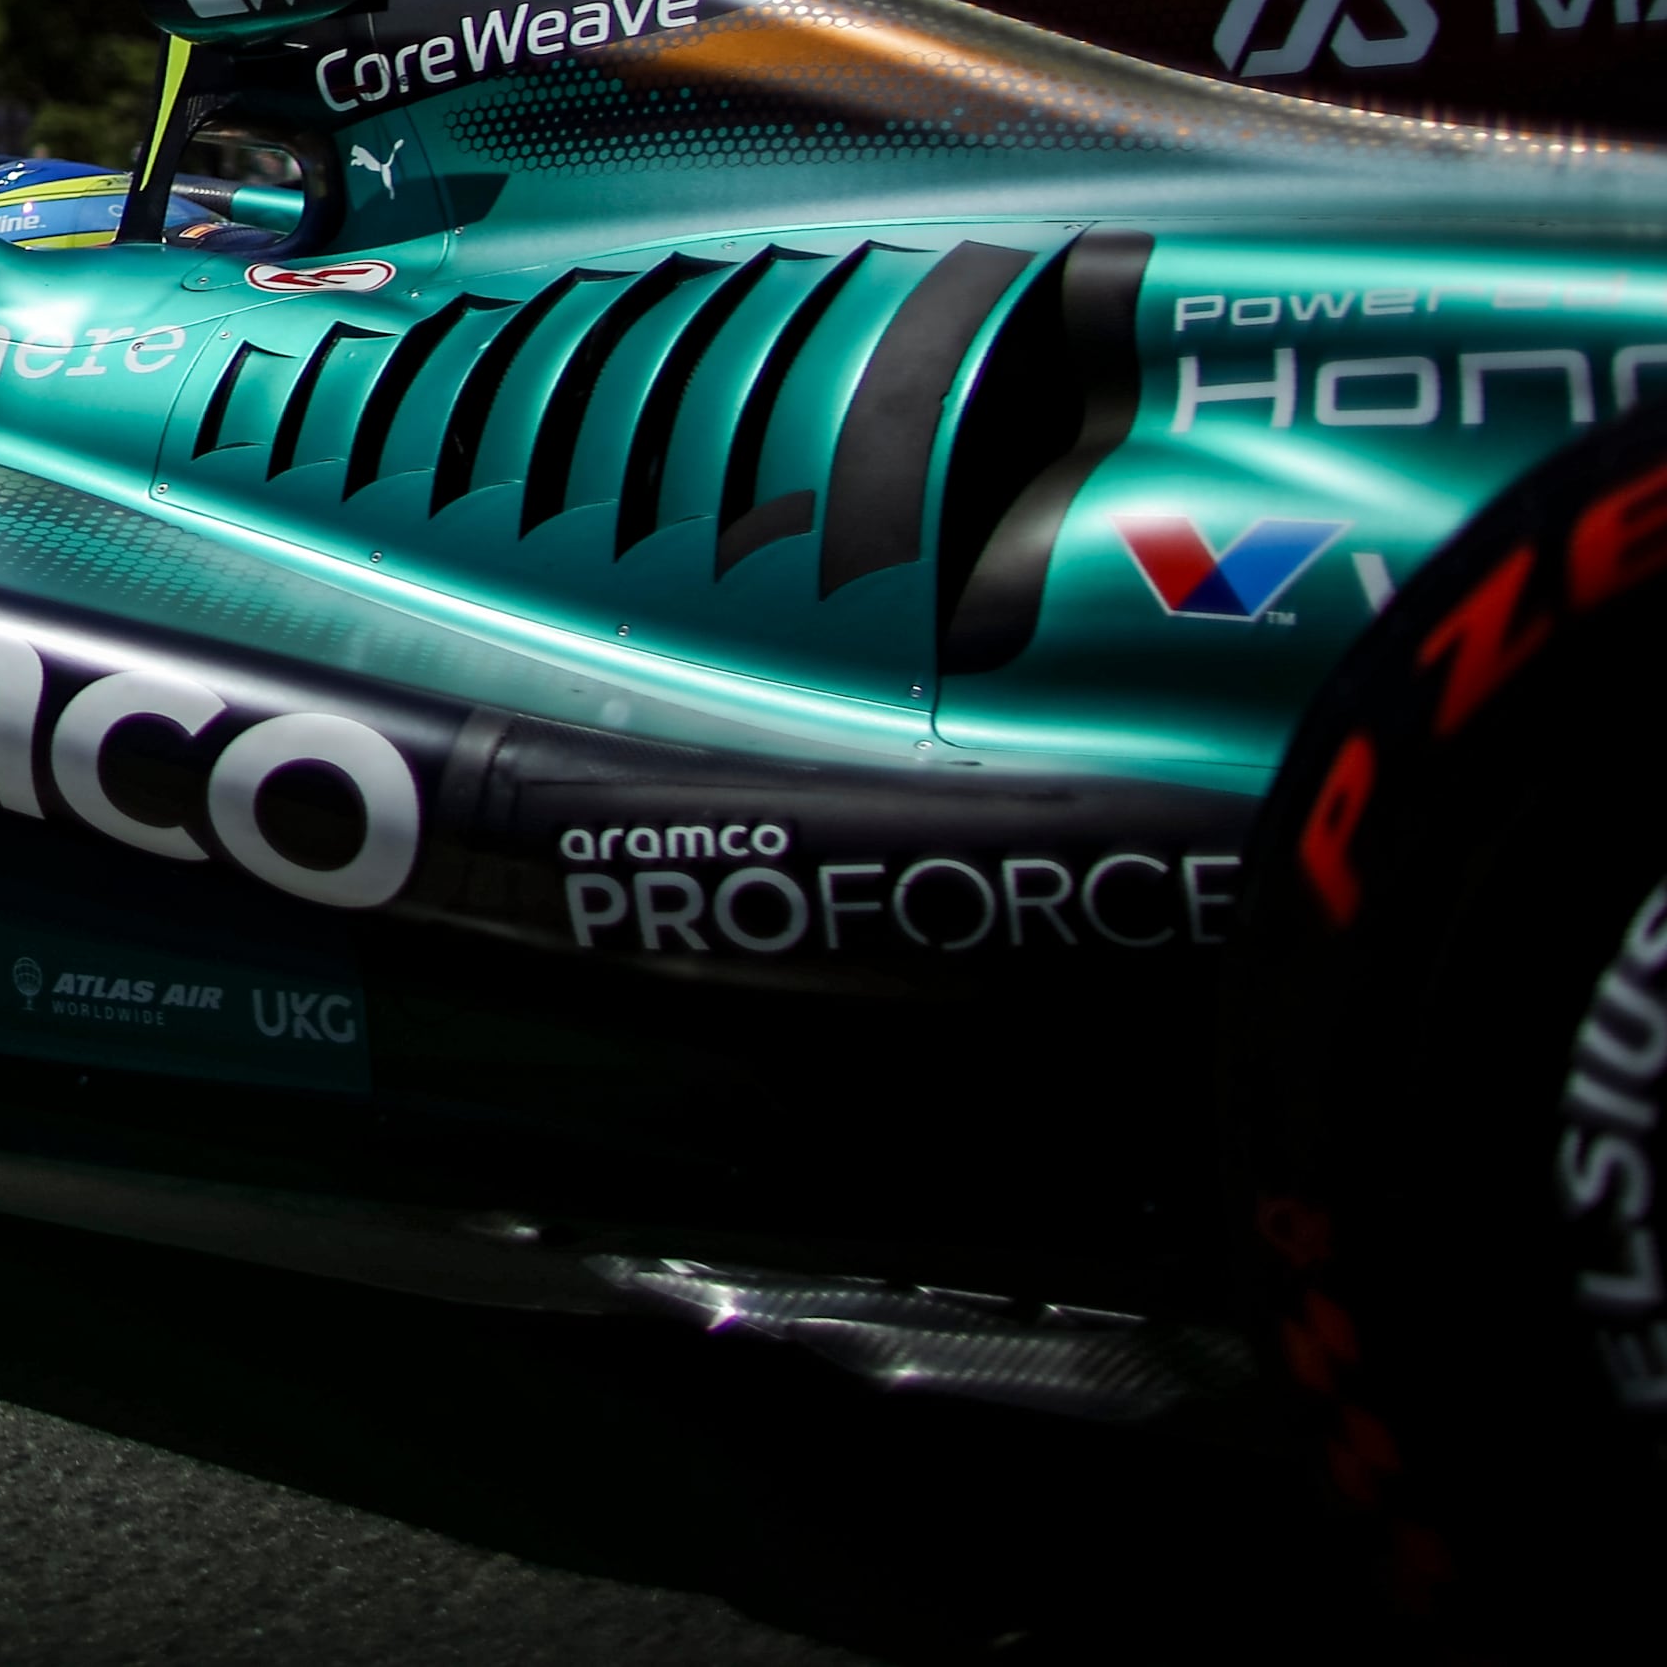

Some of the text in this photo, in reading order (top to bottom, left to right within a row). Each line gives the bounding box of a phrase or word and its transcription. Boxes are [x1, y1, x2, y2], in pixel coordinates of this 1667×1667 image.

[1174, 272, 1629, 332] Powered
[1171, 344, 1667, 434] Hon
[560, 822, 789, 862] aramco
[564, 853, 1242, 952] PROFORCE
[51, 972, 224, 1011] ATLAS AIR
[51, 999, 167, 1027] WORLDWIDE
[251, 988, 357, 1044] UKG
